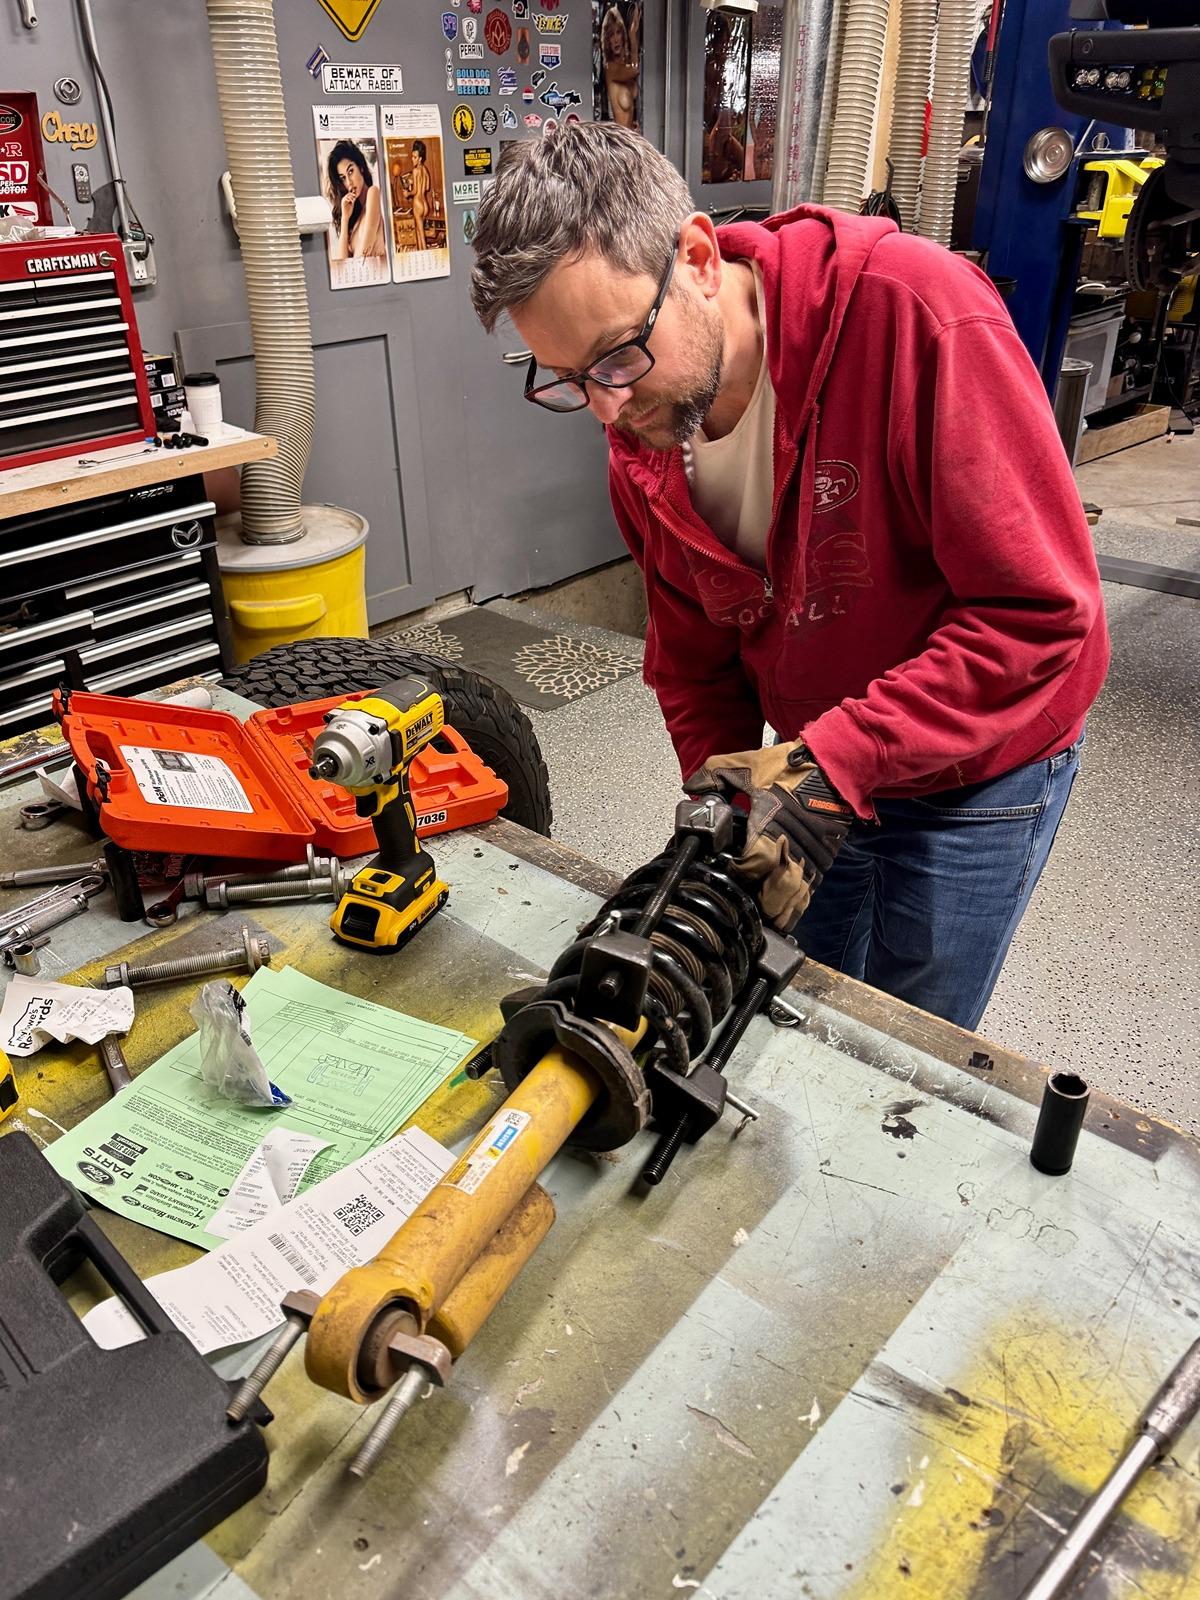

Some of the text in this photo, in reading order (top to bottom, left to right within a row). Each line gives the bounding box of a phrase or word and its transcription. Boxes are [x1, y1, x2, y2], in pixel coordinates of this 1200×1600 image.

[460, 45, 483, 57] PERRIN
[331, 68, 395, 79] BEWARE OF
[456, 69, 475, 78] BOLD
[475, 69, 490, 78] DOG
[329, 79, 399, 91] ATTACK RABBIT
[457, 86, 477, 95] BEER
[41, 111, 98, 151] Chevy
[454, 183, 479, 195] MORE
[27, 252, 98, 274] CRAFTSMAN
[153, 786, 168, 803] OEM
[417, 812, 446, 827] 7036
[106, 1138, 140, 1161] PARTS STORE
[115, 1134, 144, 1153] Motorcraft
[80, 1146, 135, 1181] PARTS
[149, 1188, 167, 1200] AWARD
[140, 1201, 167, 1219] HEIGHTS
[171, 1202, 195, 1218] Customer
